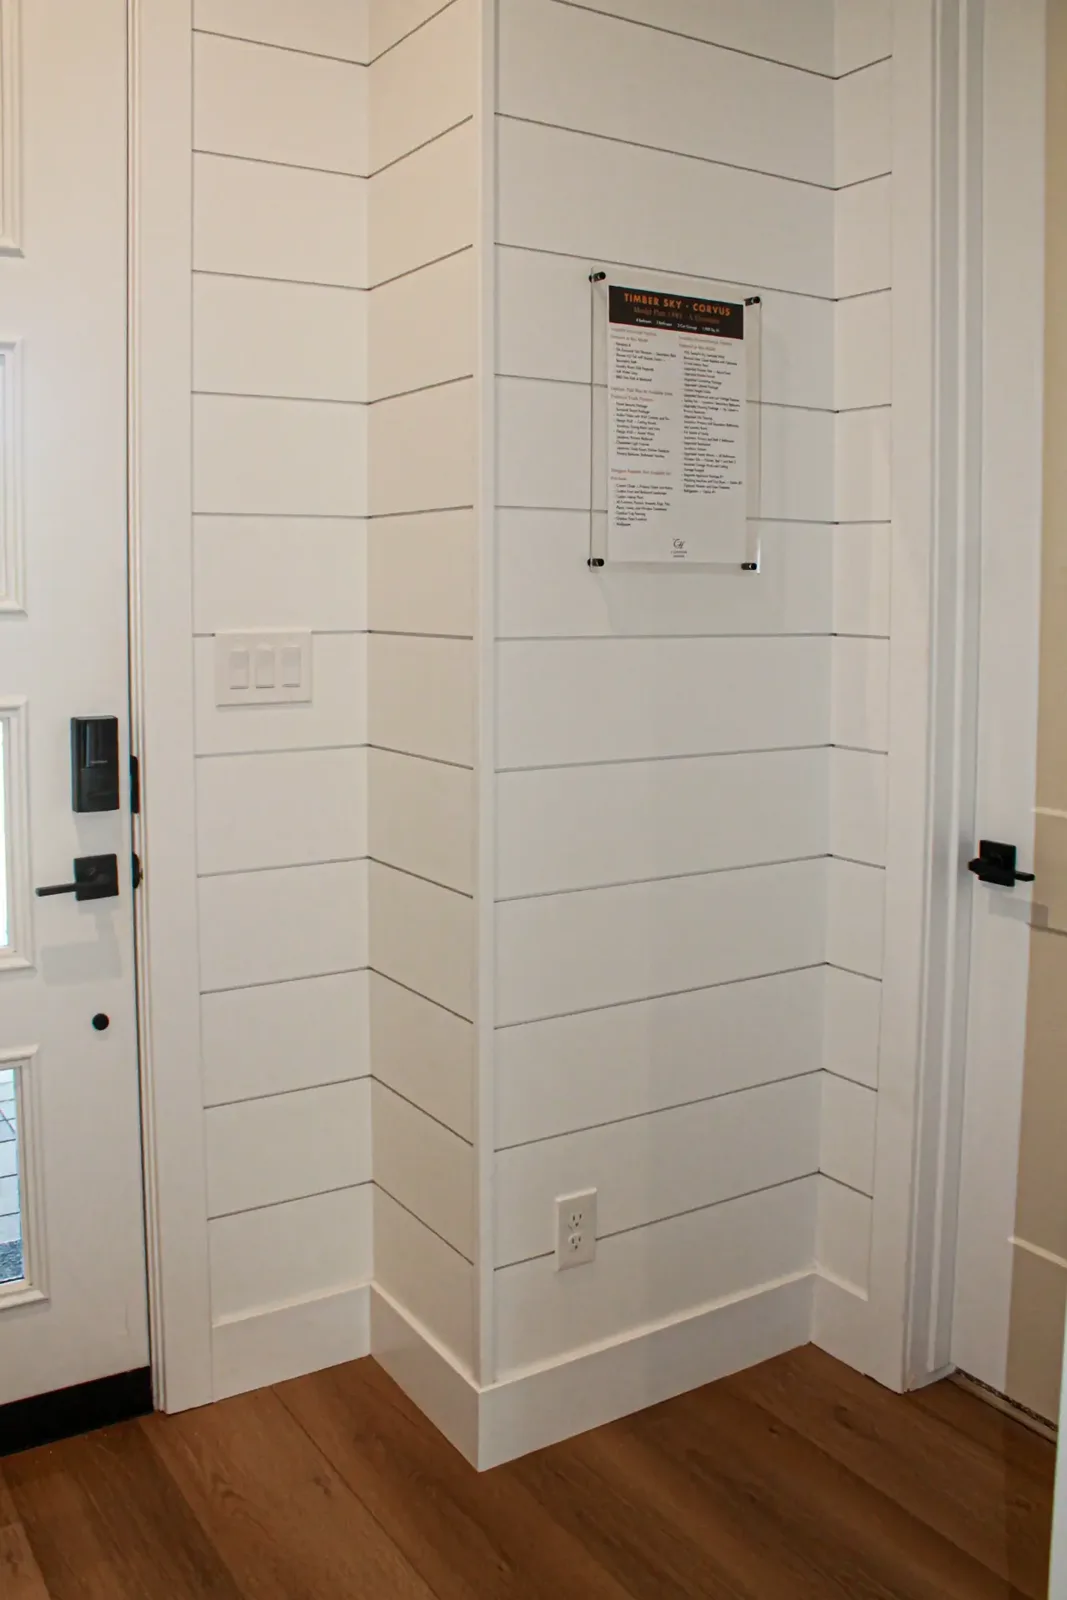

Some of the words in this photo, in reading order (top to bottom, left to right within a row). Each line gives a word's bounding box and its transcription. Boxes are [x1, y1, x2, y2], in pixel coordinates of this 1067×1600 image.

[624, 293, 660, 306] TIMBER
[663, 298, 682, 309] SKY
[693, 303, 731, 316] CORVUS
